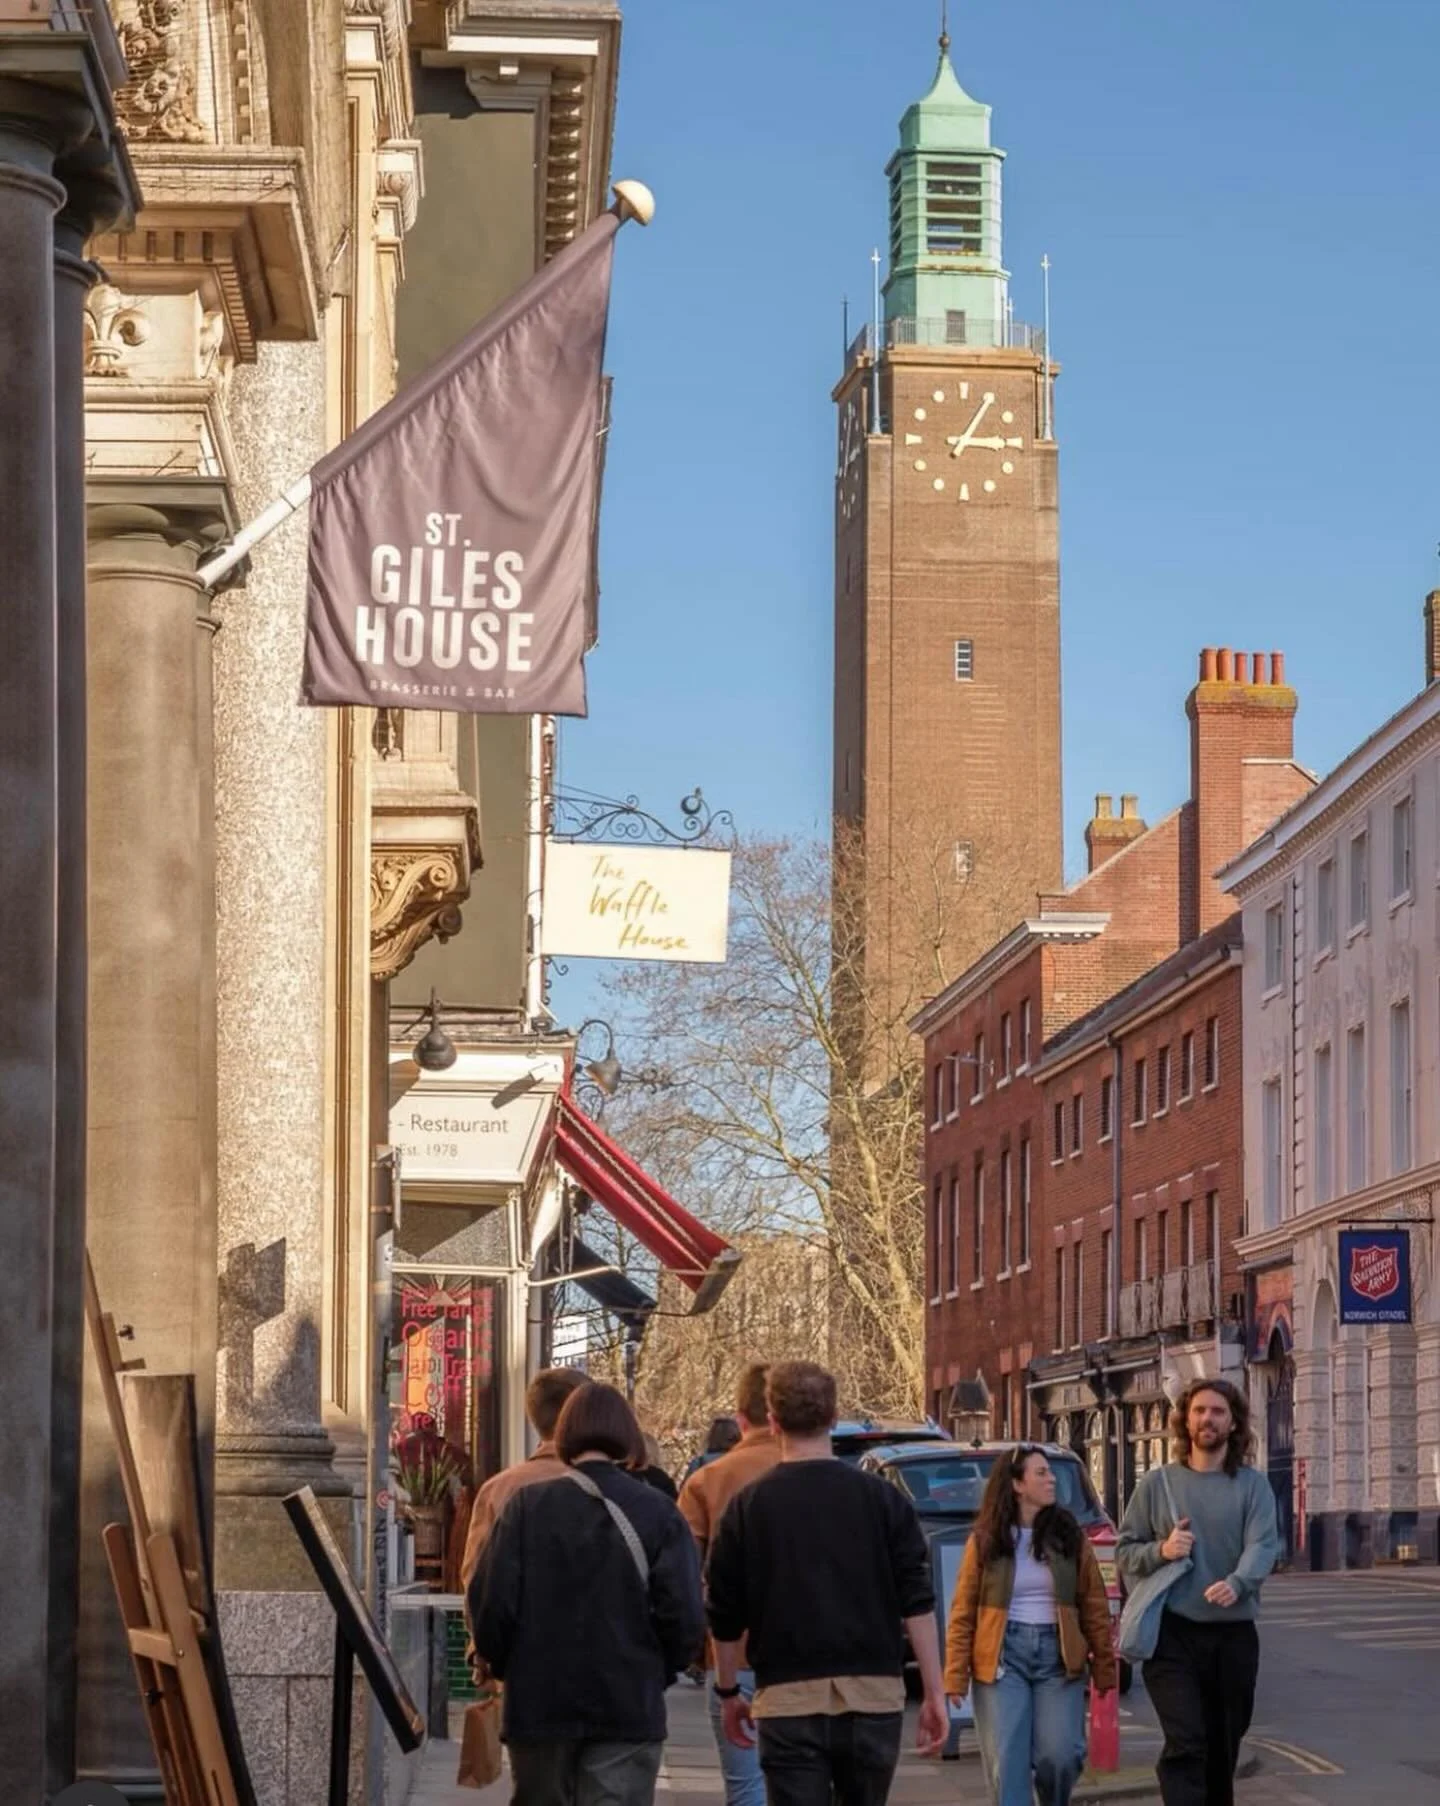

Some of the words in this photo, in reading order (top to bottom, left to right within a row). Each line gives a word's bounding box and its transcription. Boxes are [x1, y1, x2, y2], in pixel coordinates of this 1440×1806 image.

[425, 512, 471, 547] ST.
[371, 543, 524, 610] GILES
[355, 605, 535, 673] HOUSE
[370, 679, 458, 697] BRASSERIE
[484, 687, 516, 699] BAR
[590, 854, 625, 880] The
[589, 880, 670, 921] Waffle
[618, 923, 689, 950] House
[410, 1113, 510, 1133] Restaurant
[426, 1143, 459, 1158] 1978
[1359, 1250, 1379, 1269] THE
[1367, 1267, 1393, 1292] ARMY
